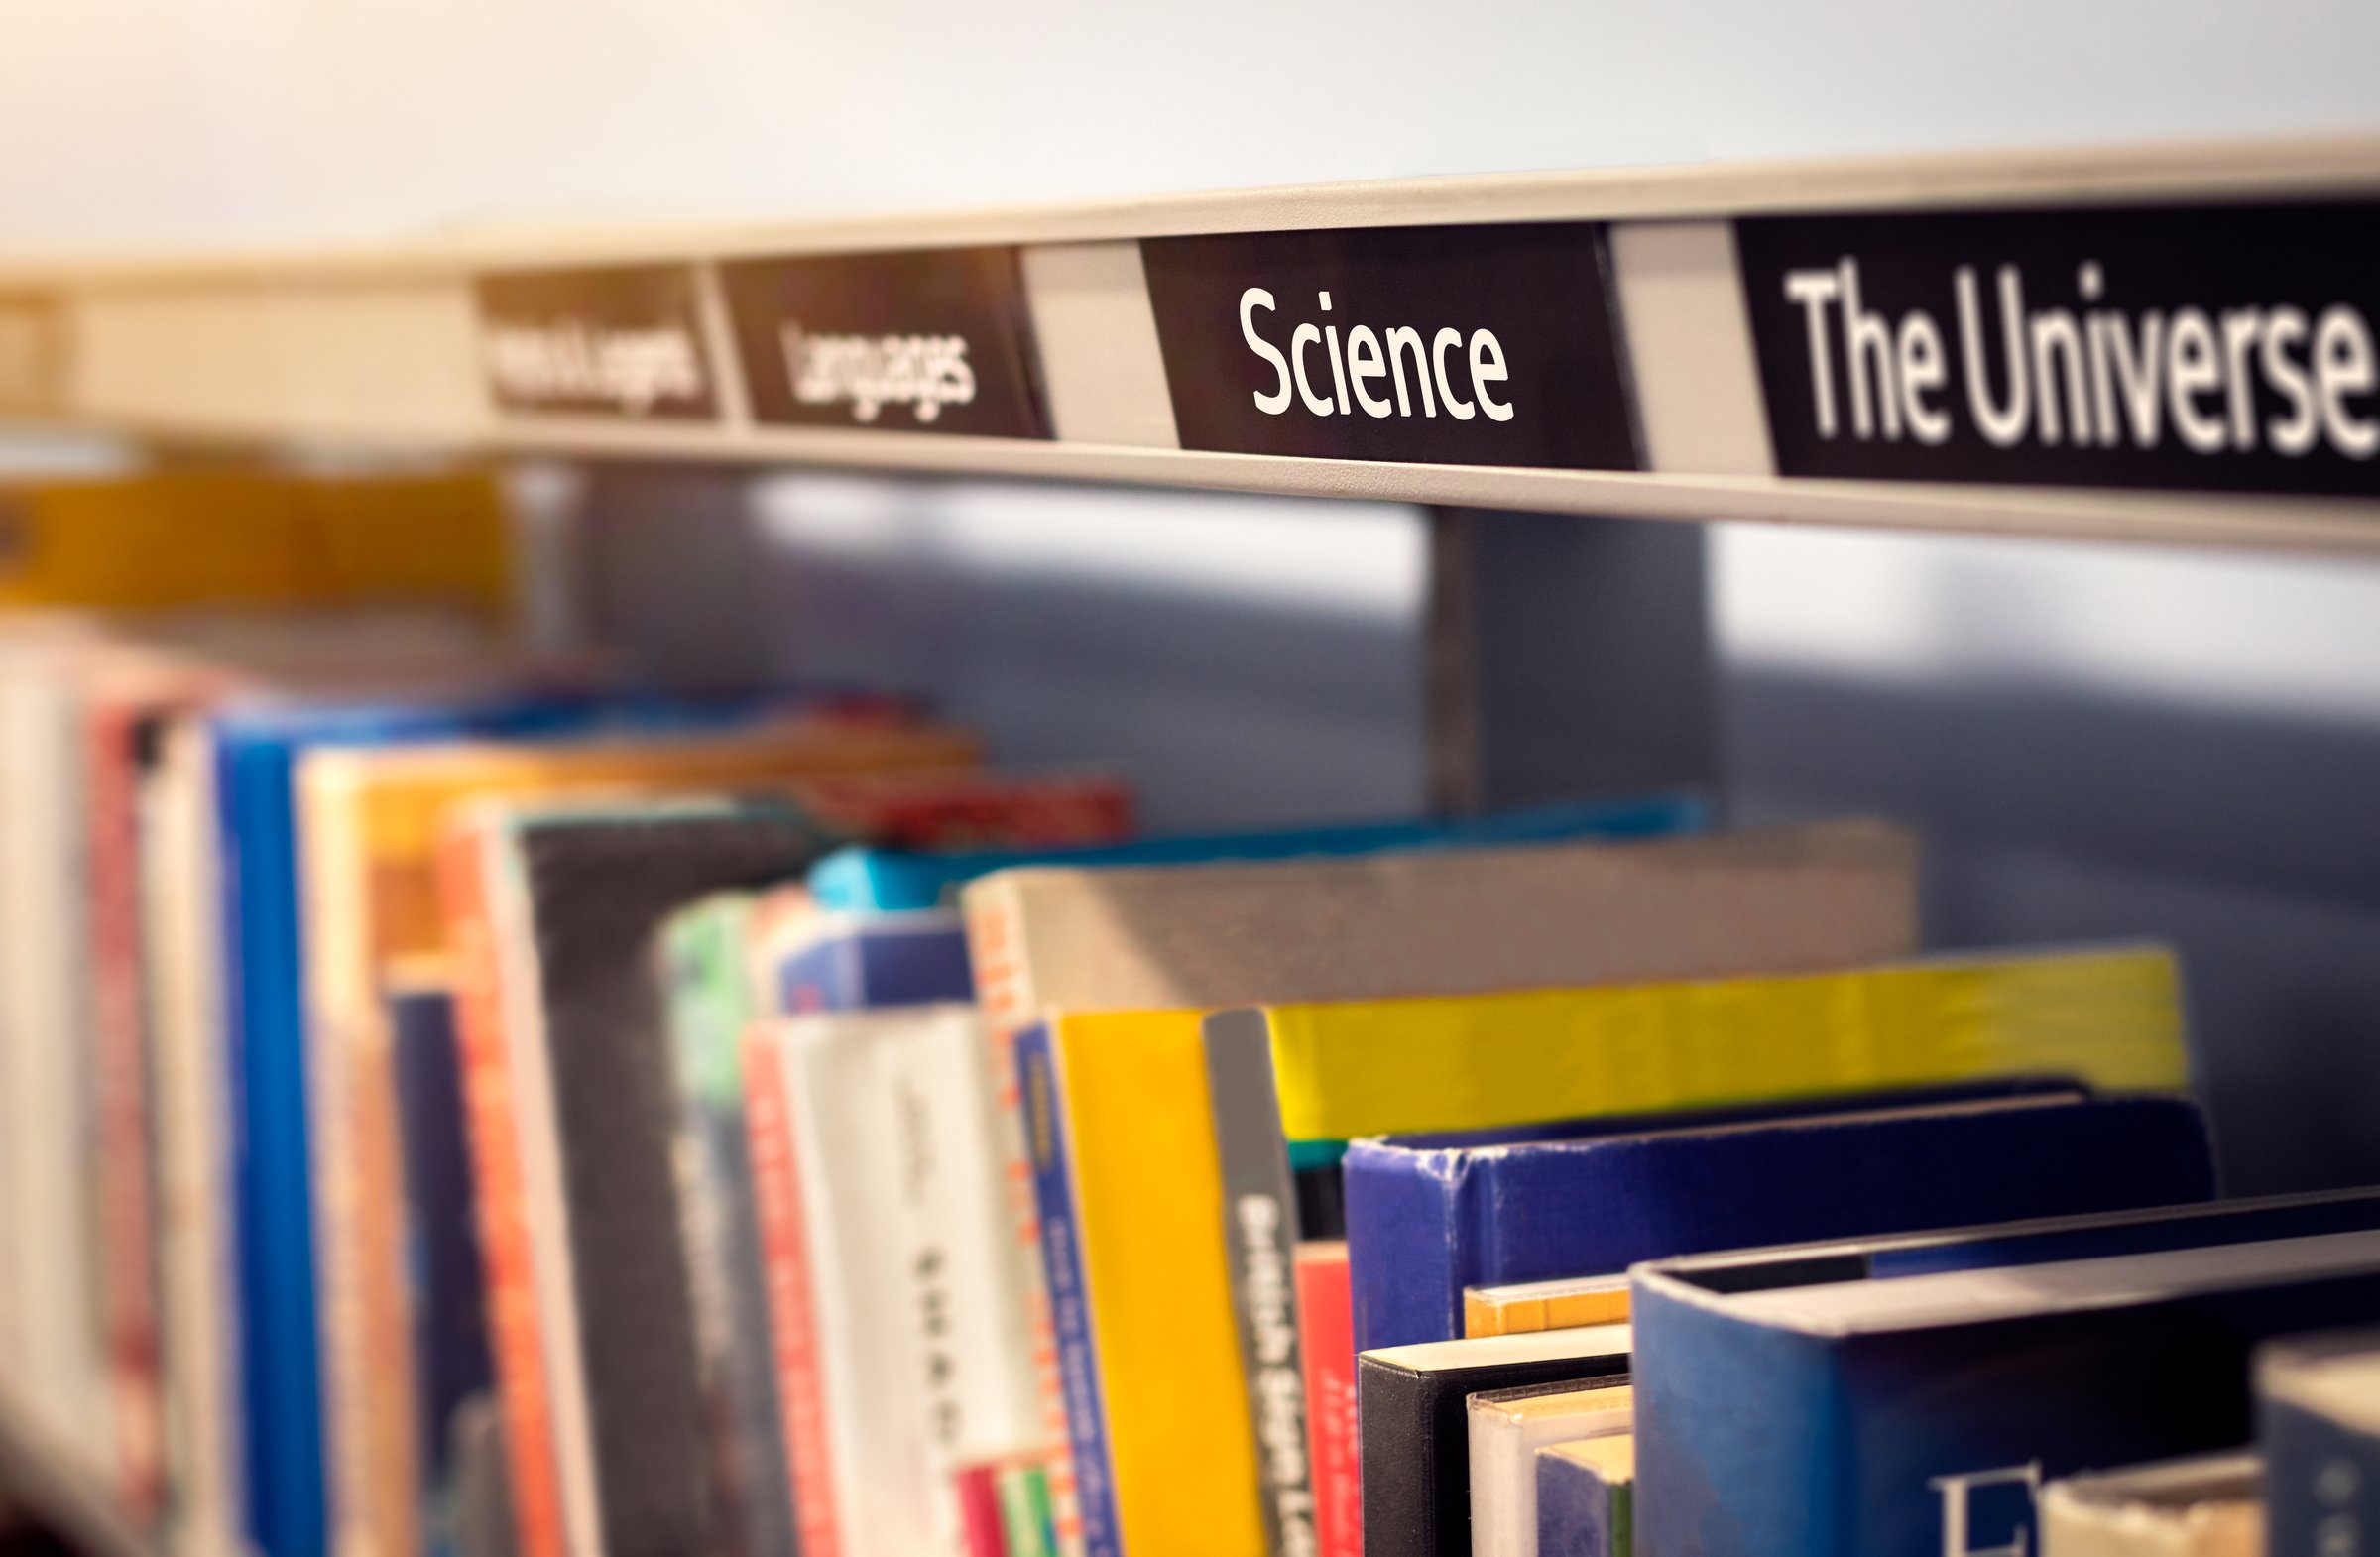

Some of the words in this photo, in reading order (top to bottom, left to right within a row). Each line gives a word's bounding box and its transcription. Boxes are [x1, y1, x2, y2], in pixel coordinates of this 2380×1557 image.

[778, 318, 976, 423] Languages
[1238, 286, 1515, 423] Science
[1784, 253, 1952, 445] The
[1953, 259, 2380, 460] Universe
